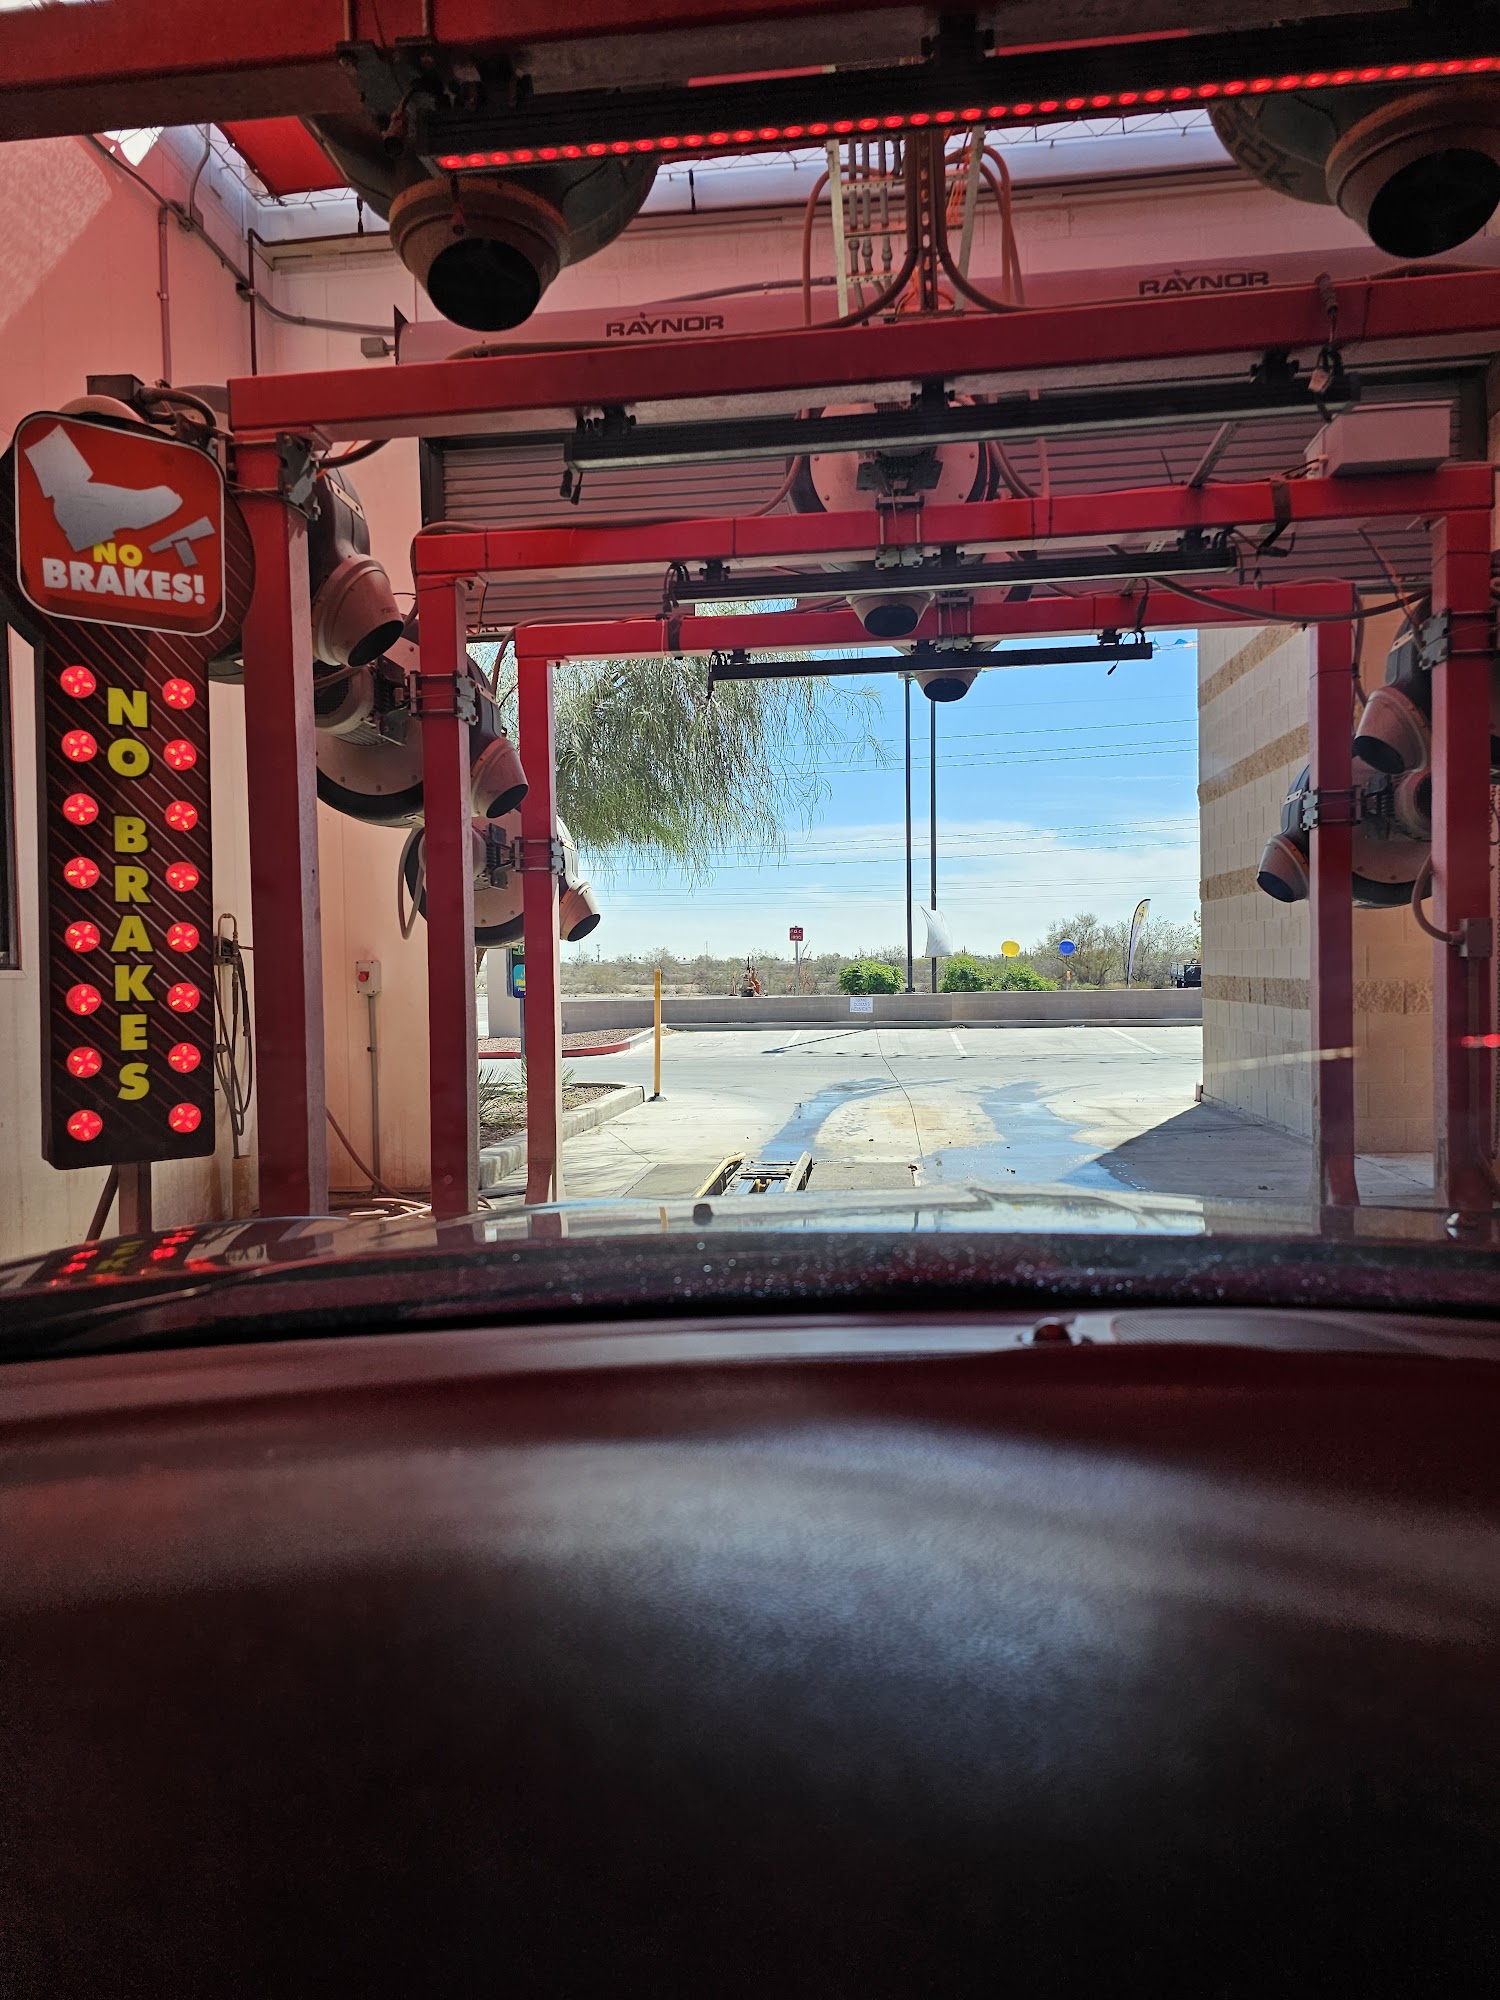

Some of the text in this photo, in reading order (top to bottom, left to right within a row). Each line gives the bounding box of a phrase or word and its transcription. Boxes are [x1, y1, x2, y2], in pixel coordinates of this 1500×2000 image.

[1139, 271, 1269, 296] RAYNOR
[606, 314, 725, 338] RAYNOR
[93, 541, 144, 568] NO
[42, 558, 206, 605] BRAKES!
[107, 687, 154, 1102] NO BRAKES
